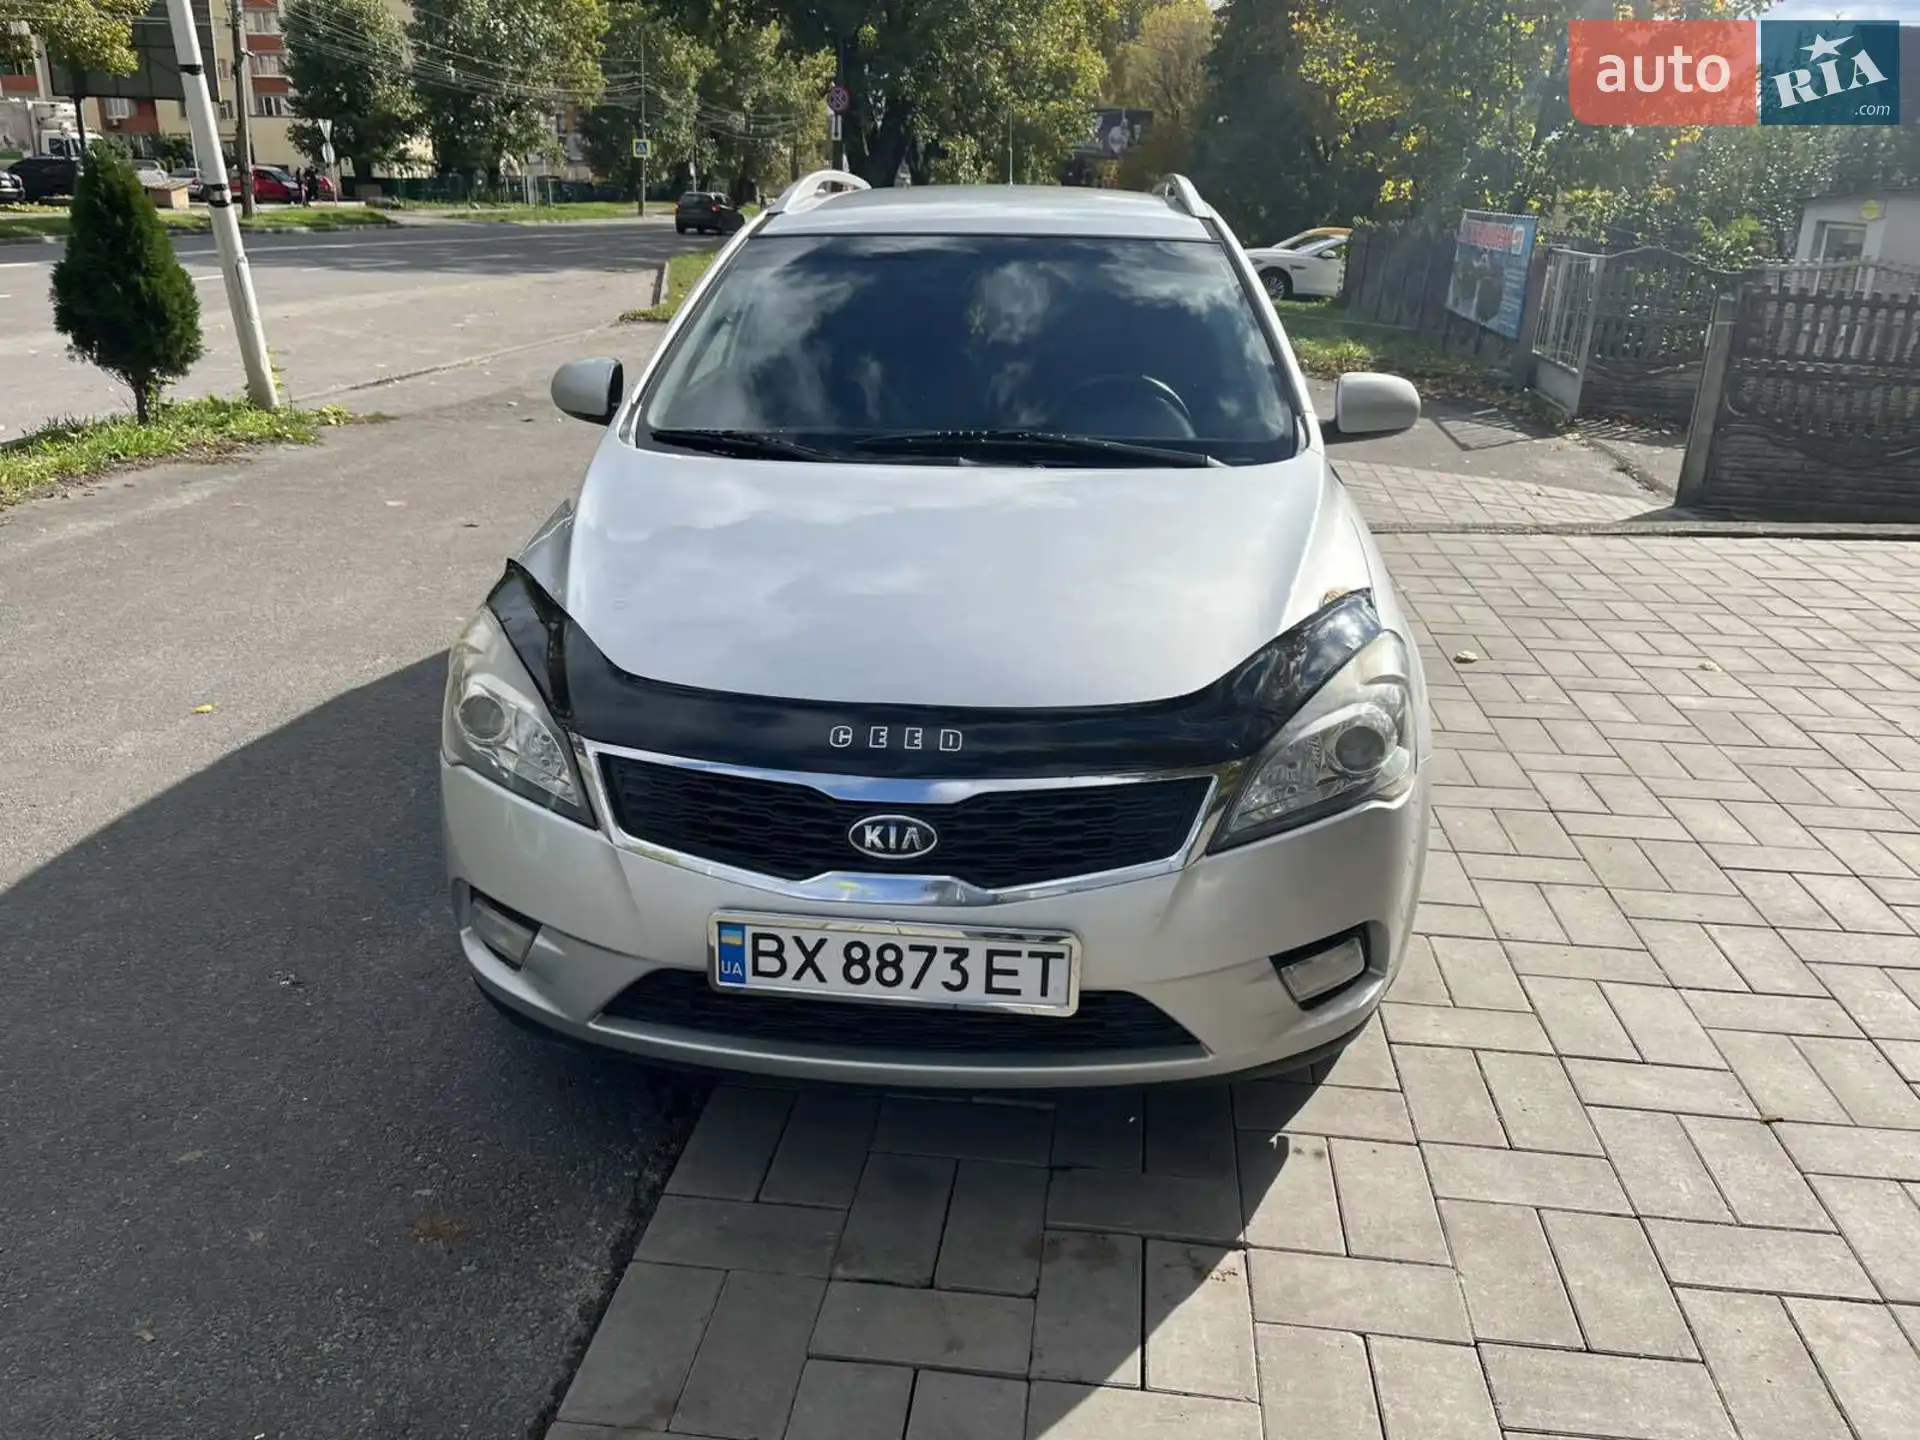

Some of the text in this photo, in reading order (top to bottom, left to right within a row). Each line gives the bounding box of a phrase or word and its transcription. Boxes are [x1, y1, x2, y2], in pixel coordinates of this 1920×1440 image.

[829, 725, 963, 752] CEED
[864, 823, 921, 850] KIA
[721, 960, 743, 978] UA
[751, 931, 1066, 998] BX 8873 ET
